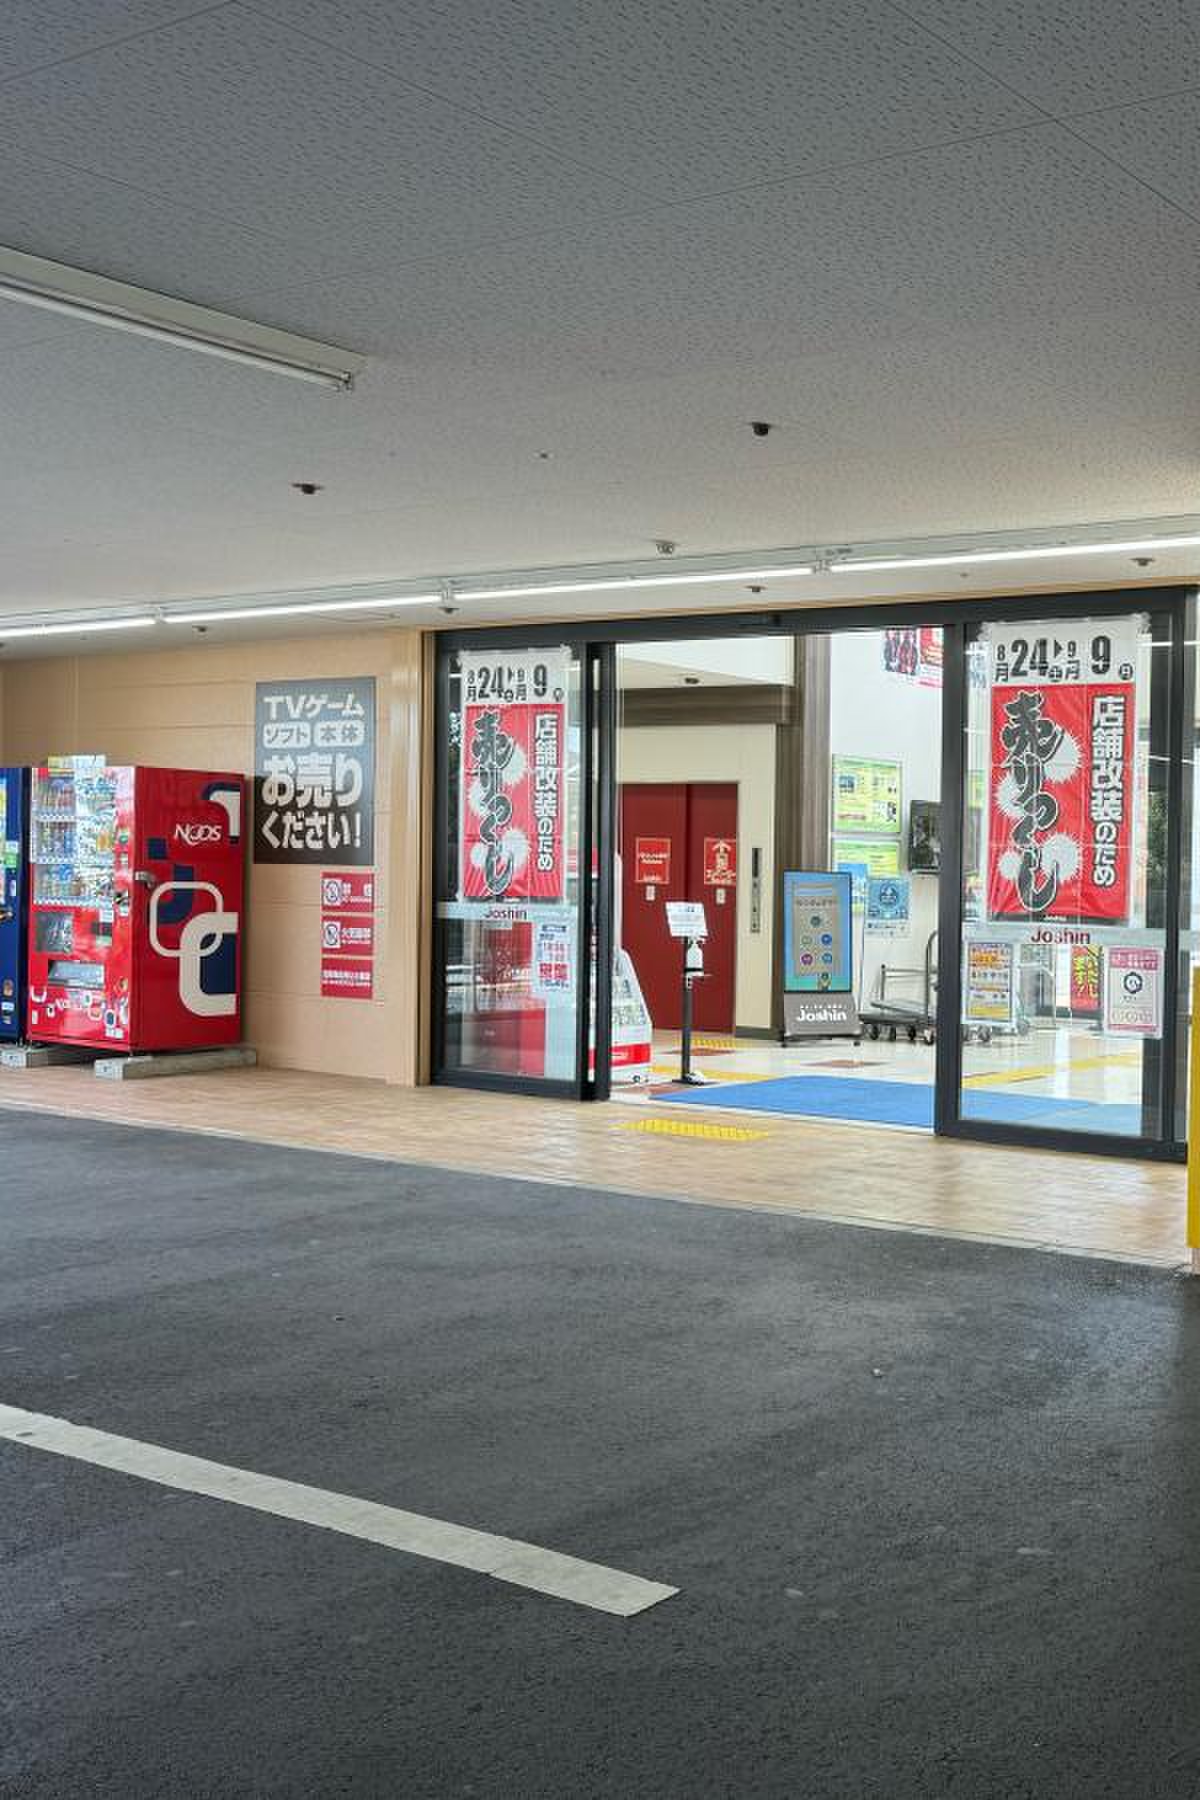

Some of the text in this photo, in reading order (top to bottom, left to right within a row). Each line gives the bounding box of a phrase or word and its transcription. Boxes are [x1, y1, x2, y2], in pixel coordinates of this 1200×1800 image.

[263, 693, 365, 720] TVゲーム
[265, 724, 358, 745] ソフト 本体
[261, 752, 363, 808] お売り
[1090, 696, 1125, 888] 店舗改装のため
[261, 811, 361, 849] ください!
[1031, 928, 1091, 944] Joshin
[797, 1009, 847, 1021] Joshin
